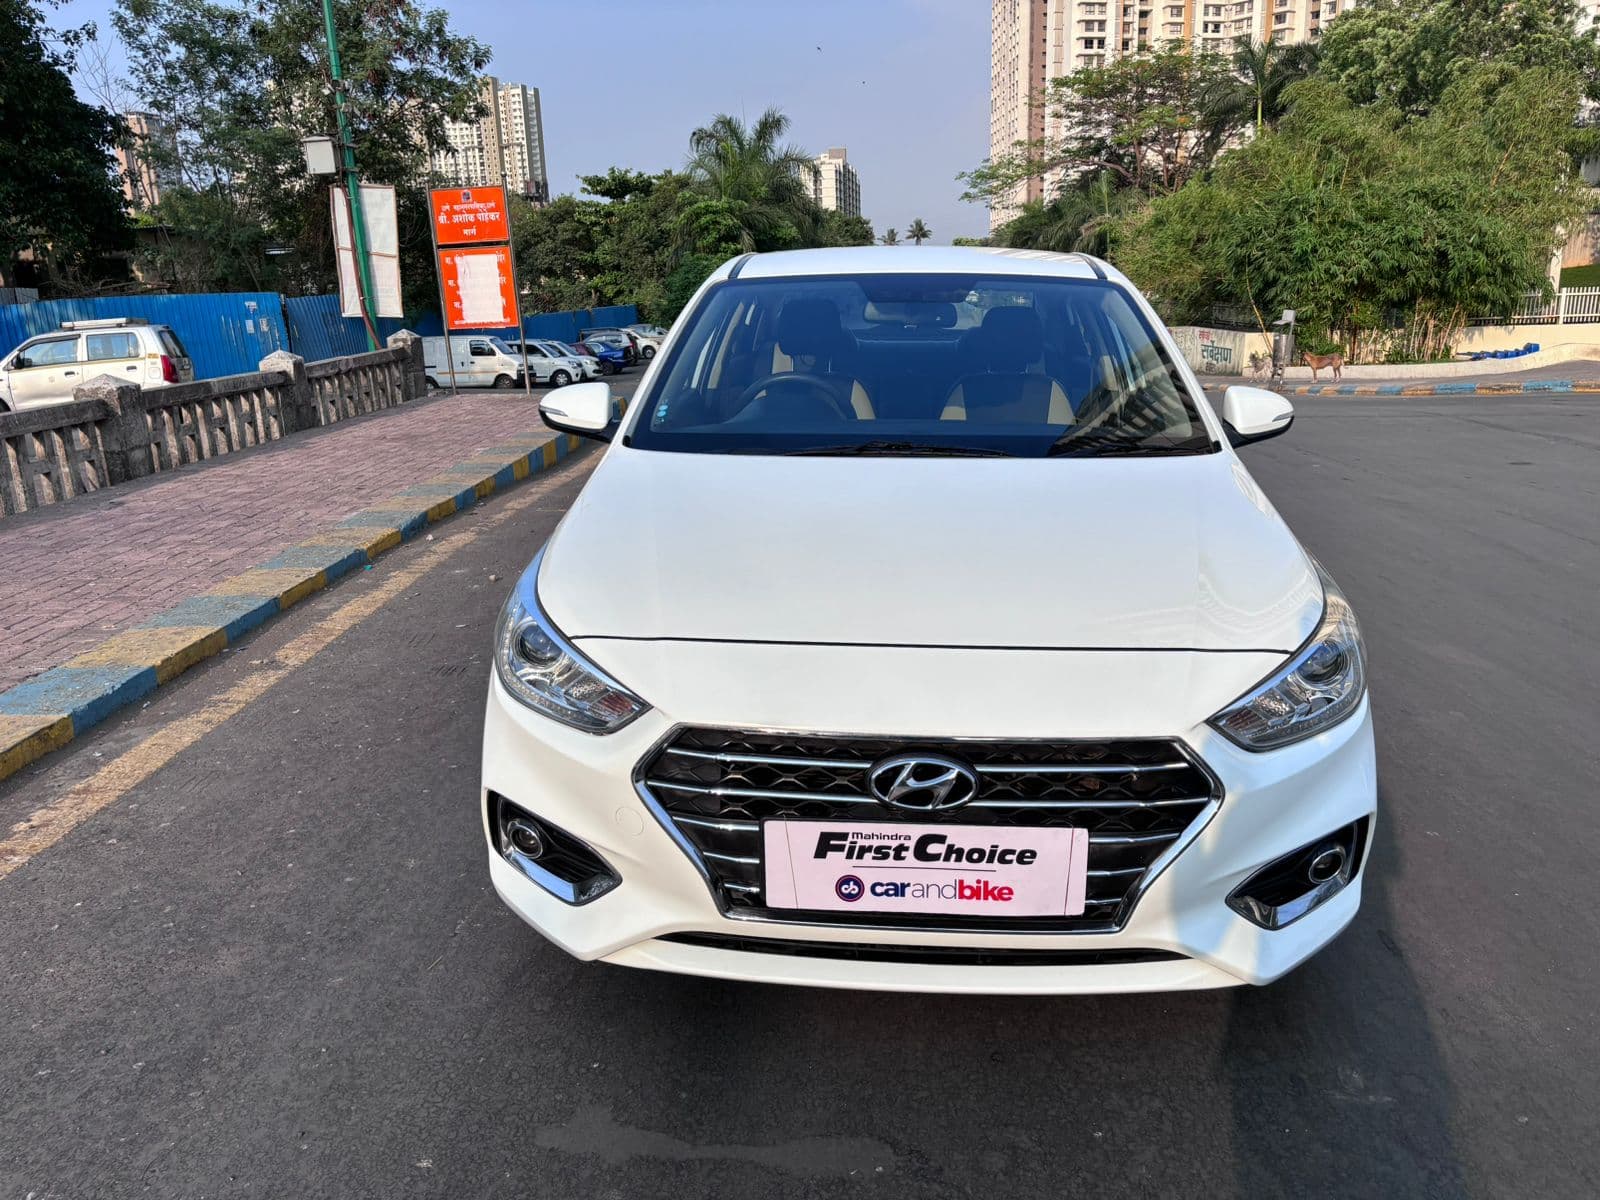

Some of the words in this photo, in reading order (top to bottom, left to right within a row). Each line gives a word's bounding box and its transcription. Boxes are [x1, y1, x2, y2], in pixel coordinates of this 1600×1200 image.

[452, 210, 475, 224] अशोक
[463, 225, 477, 236] मार्ग
[1200, 340, 1232, 364] सर्वेक्षण
[852, 832, 911, 841] Mahindra
[814, 831, 910, 861] First
[913, 834, 1037, 865] Choice
[870, 879, 1014, 901] carandbike
